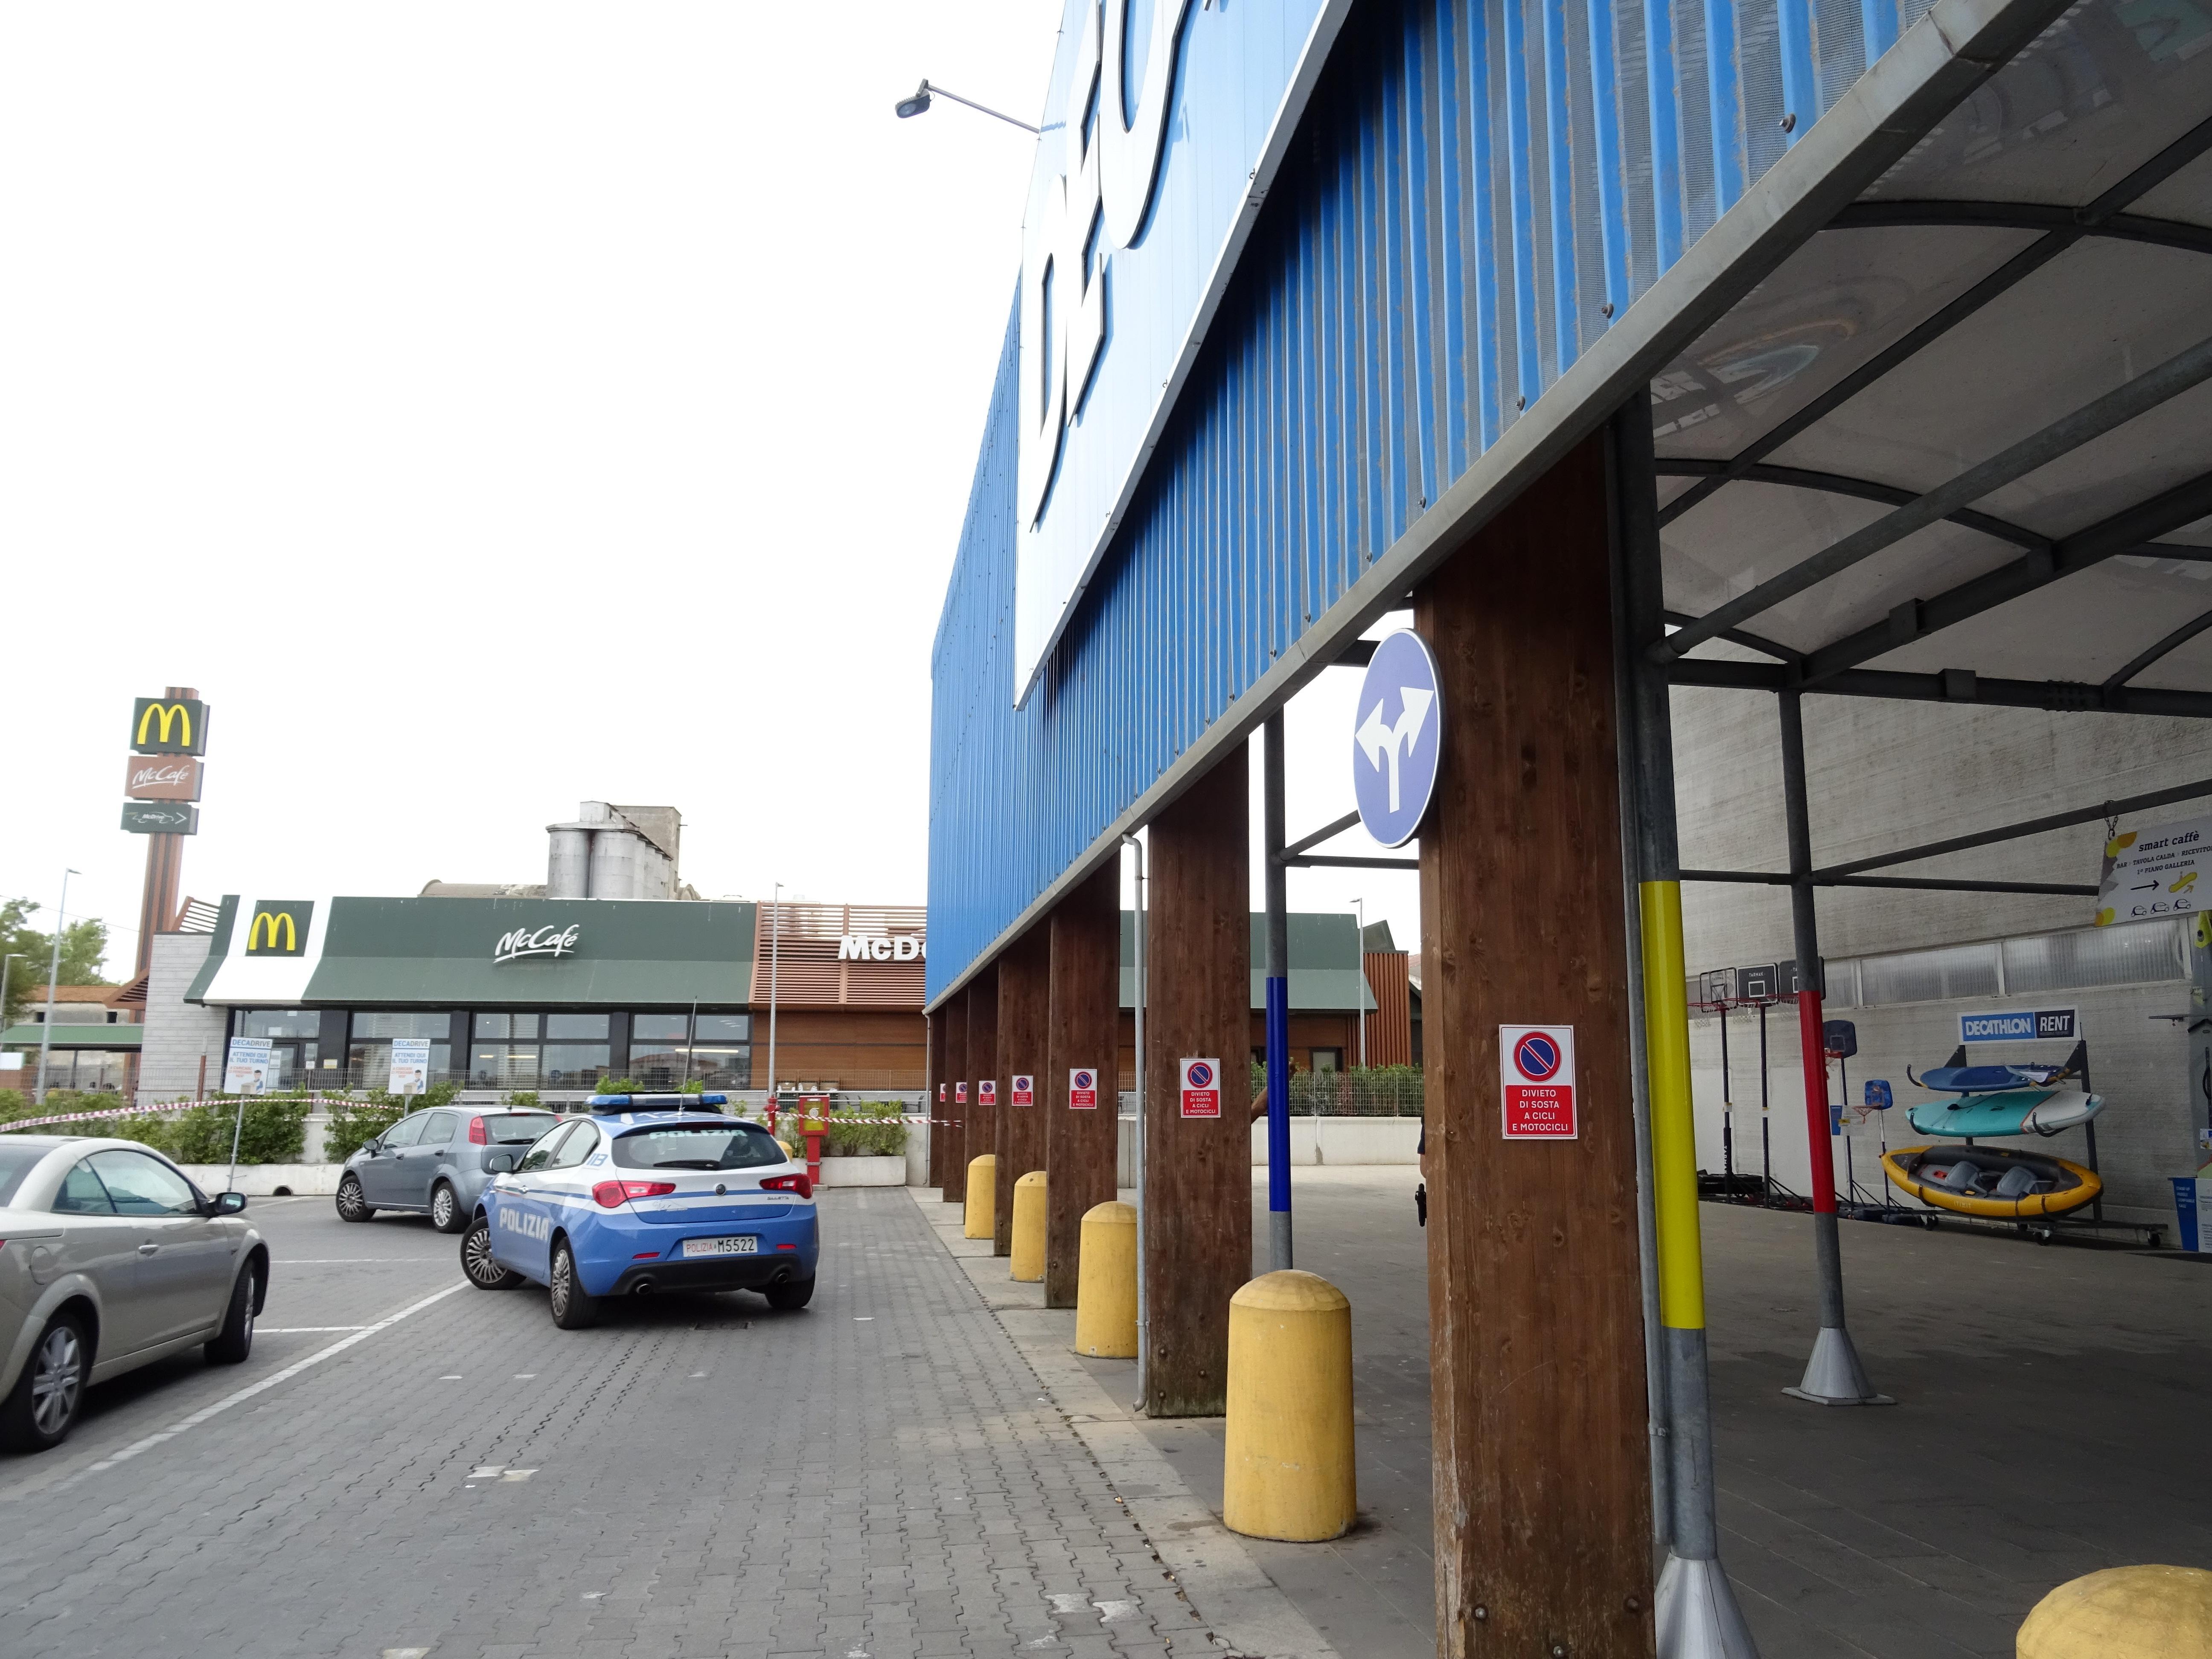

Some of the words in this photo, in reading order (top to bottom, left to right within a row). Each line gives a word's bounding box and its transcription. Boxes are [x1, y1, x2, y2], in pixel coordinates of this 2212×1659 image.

[2139, 838, 2168, 852] smart
[2172, 830, 2199, 845] caffè
[2133, 856, 2154, 866] TAVOLA
[2156, 853, 2175, 861] CALDA
[2181, 845, 2212, 856] RICEVITO
[2165, 860, 2195, 869] GALLERIA
[495, 924, 579, 960] McCafé
[838, 935, 926, 960] McD
[1965, 1018, 2031, 1036] DECATHLON
[2040, 1016, 2070, 1031] RENT
[649, 1129, 748, 1139] POLIZIA
[500, 1207, 550, 1242] POLIZIA
[687, 1243, 713, 1253] POLIZIA
[718, 1239, 754, 1252] M5522
